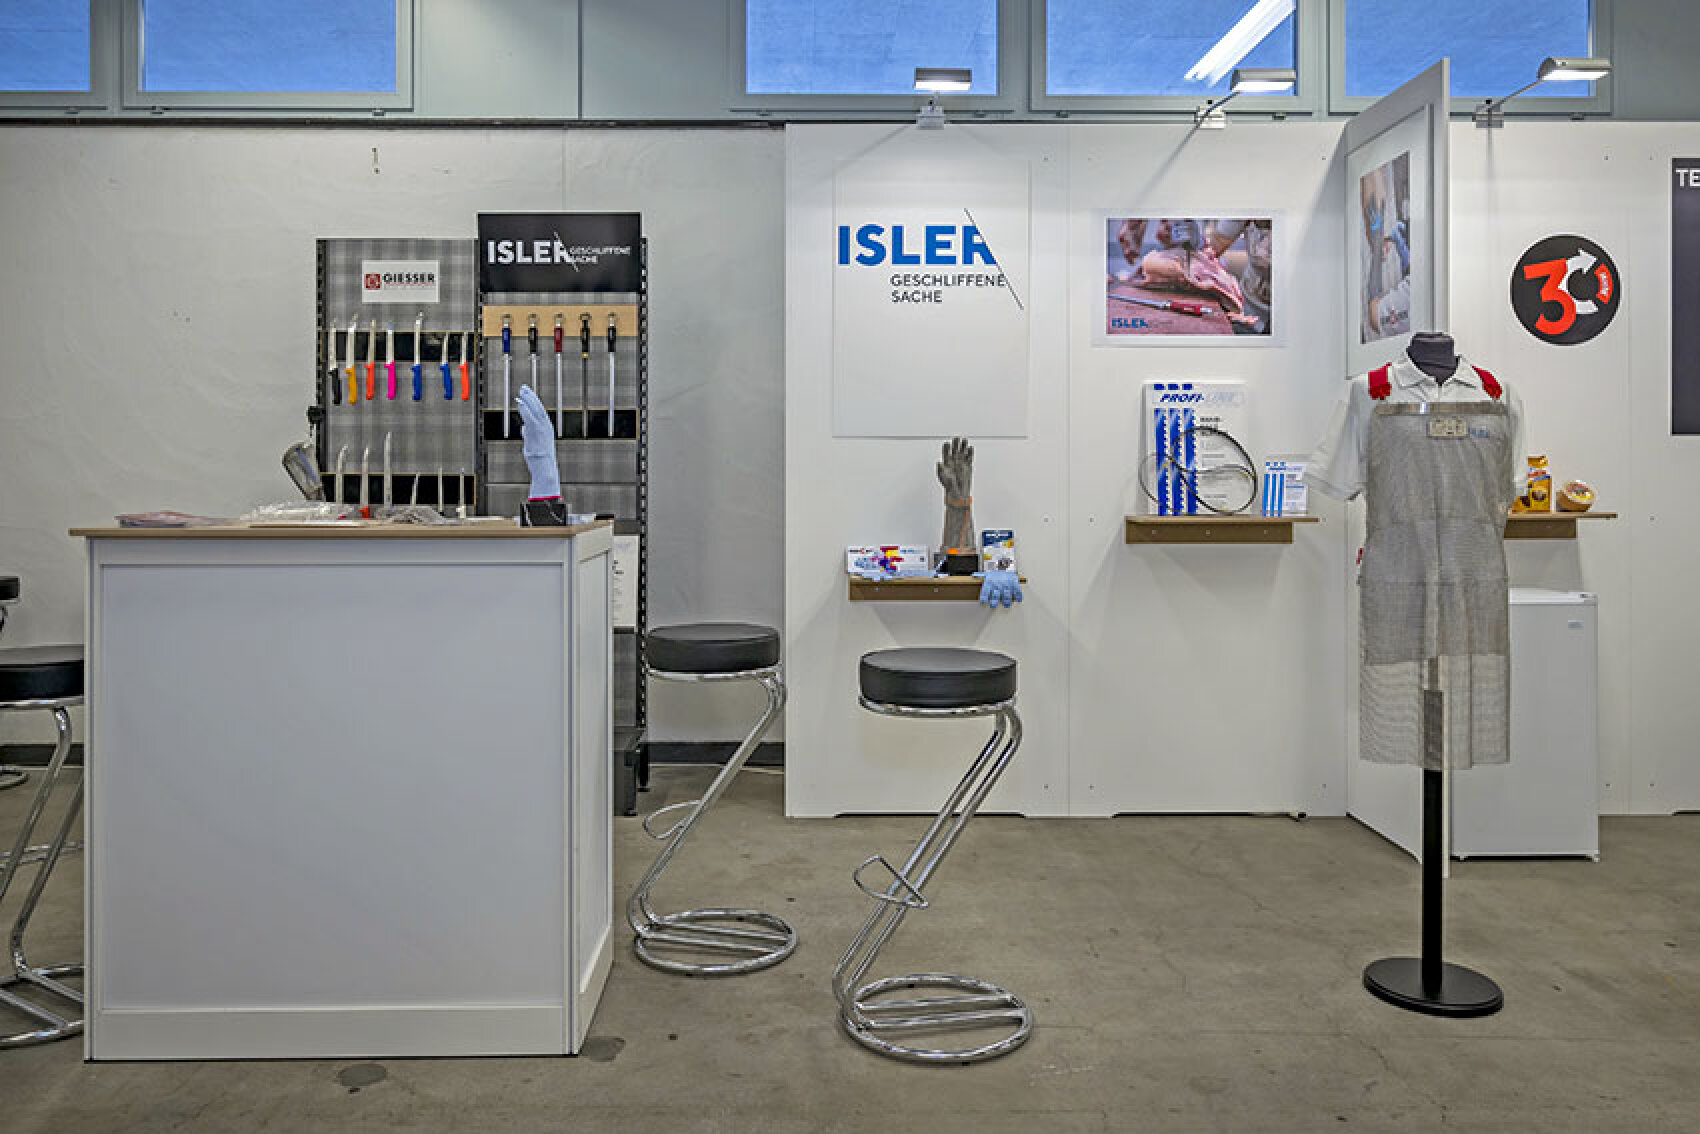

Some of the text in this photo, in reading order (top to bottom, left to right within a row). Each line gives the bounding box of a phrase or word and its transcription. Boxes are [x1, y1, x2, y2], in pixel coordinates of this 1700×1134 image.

[1675, 167, 1700, 187] TE
[487, 239, 572, 264] ISLER
[837, 223, 998, 267] ISLER
[383, 271, 436, 284] GIESSER
[890, 273, 1008, 288] GESCHLIFFENE
[890, 289, 944, 304] SACHE
